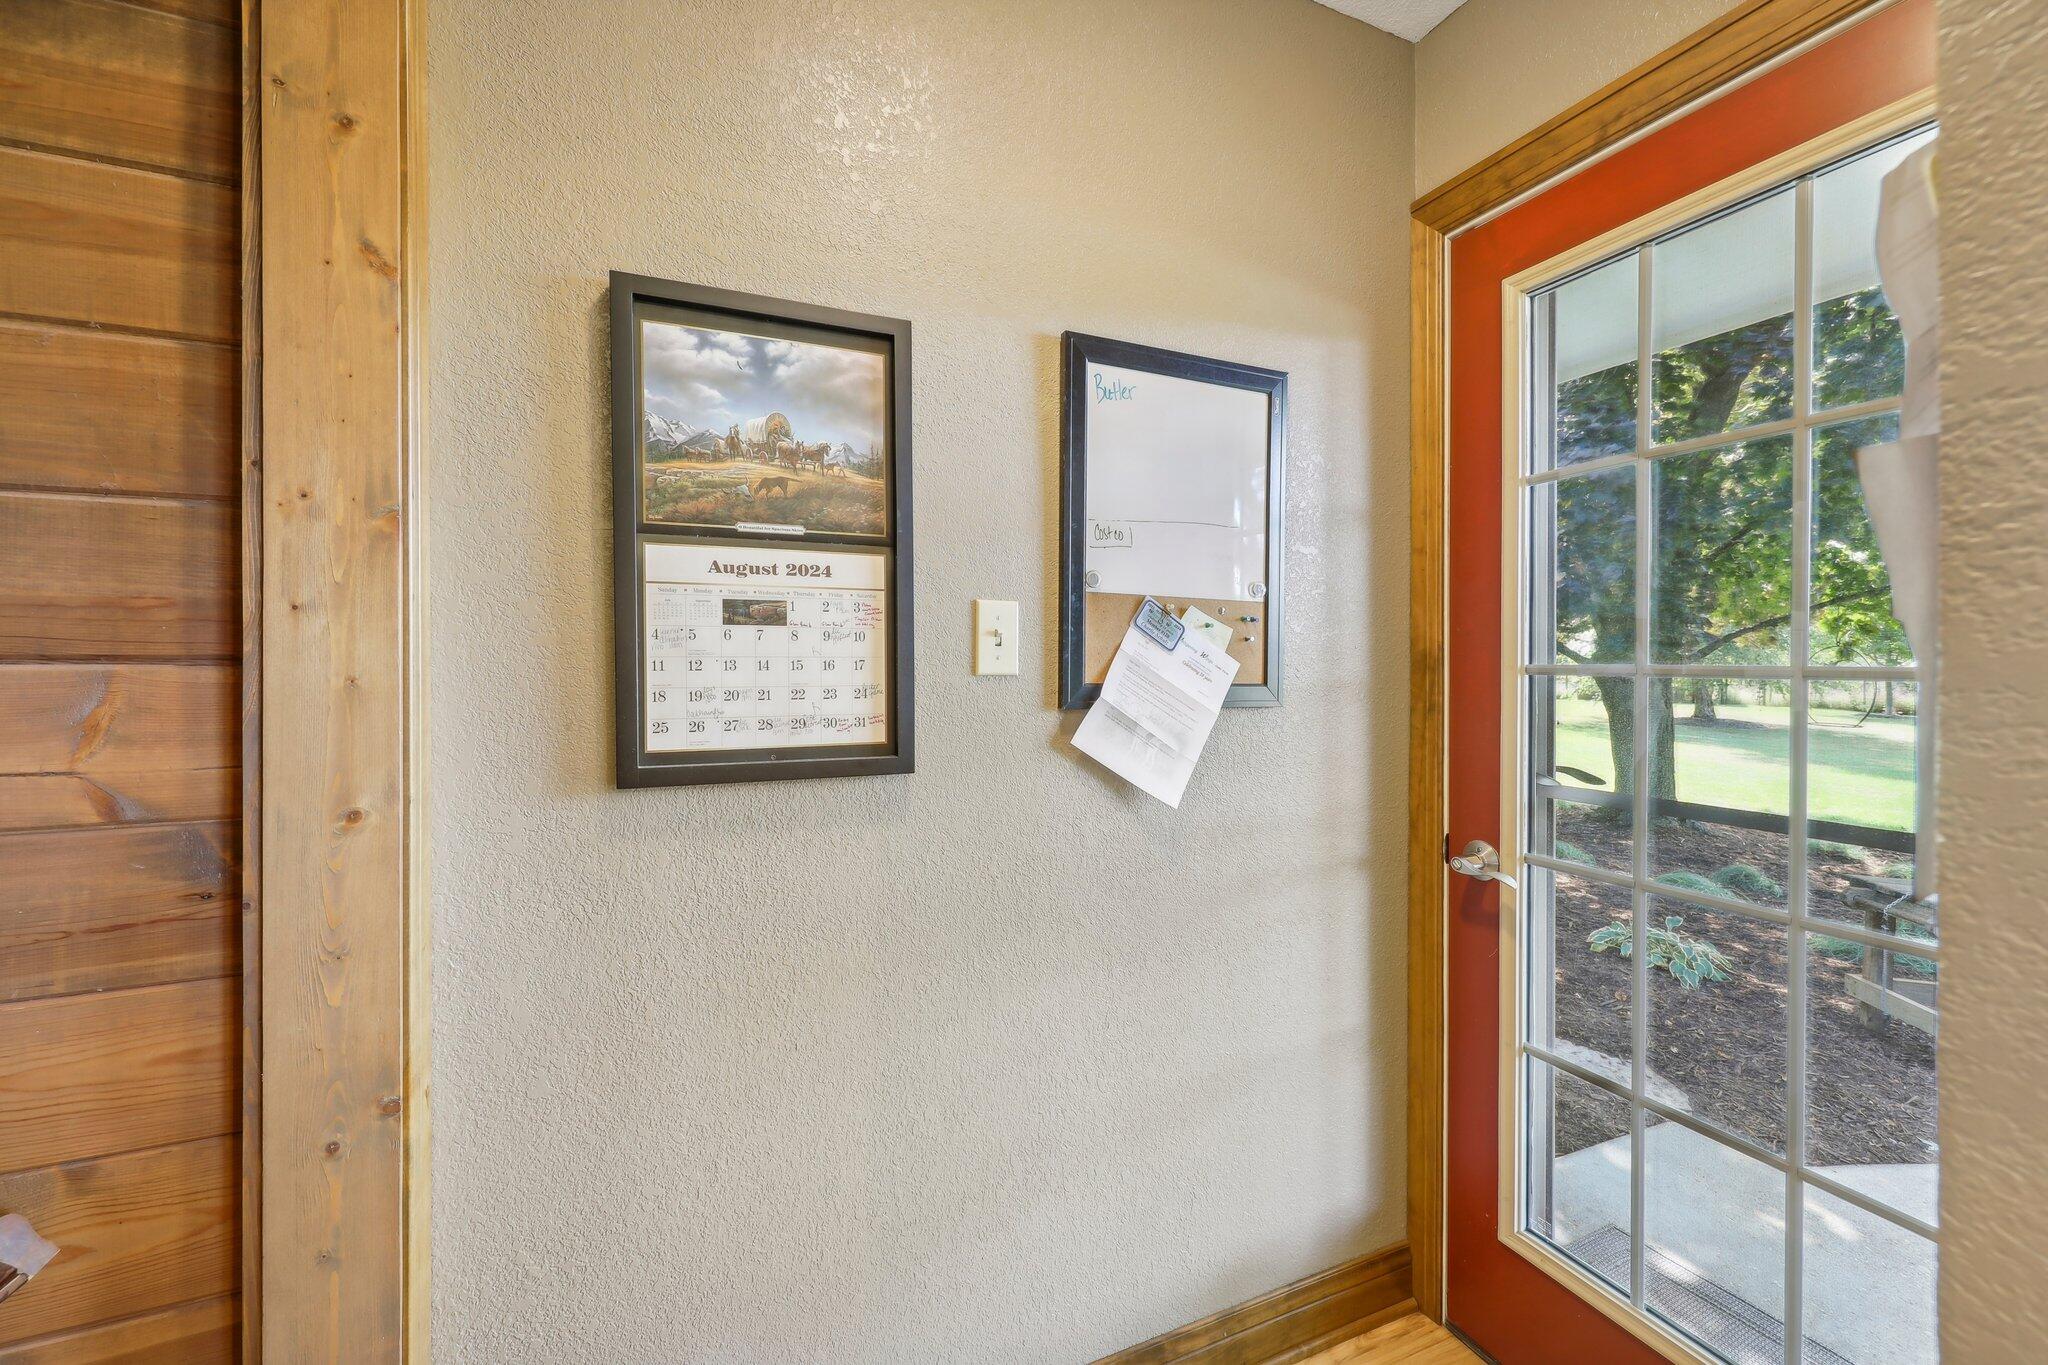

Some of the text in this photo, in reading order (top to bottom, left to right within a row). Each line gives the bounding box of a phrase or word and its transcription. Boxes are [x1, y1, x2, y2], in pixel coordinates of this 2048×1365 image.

[1094, 523, 1124, 541] Costco
[708, 560, 833, 579] August 2024
[657, 585, 678, 593] Sunday
[727, 588, 749, 596] Tuesday
[790, 601, 796, 612] 1
[822, 601, 830, 613] 2
[853, 602, 861, 614] 3
[651, 628, 660, 640] 4
[688, 628, 696, 641] 5
[723, 628, 732, 641] 6
[757, 629, 764, 641] 7
[790, 630, 799, 642] 8
[823, 630, 831, 642] 9
[854, 631, 866, 643] 10
[652, 659, 866, 672] 11 12 13 14 15 16 17
[652, 690, 667, 703] 18
[688, 690, 703, 703] 19
[723, 689, 740, 702] 20
[757, 689, 772, 701] 21
[790, 688, 806, 700] 22
[823, 688, 838, 700] 23
[854, 687, 868, 700] 24
[652, 721, 669, 734] 25
[688, 720, 705, 733] 26
[723, 719, 739, 732] 27
[757, 718, 774, 731] 28
[790, 717, 806, 730] 29
[823, 717, 838, 729] 30
[854, 716, 867, 728] 31
